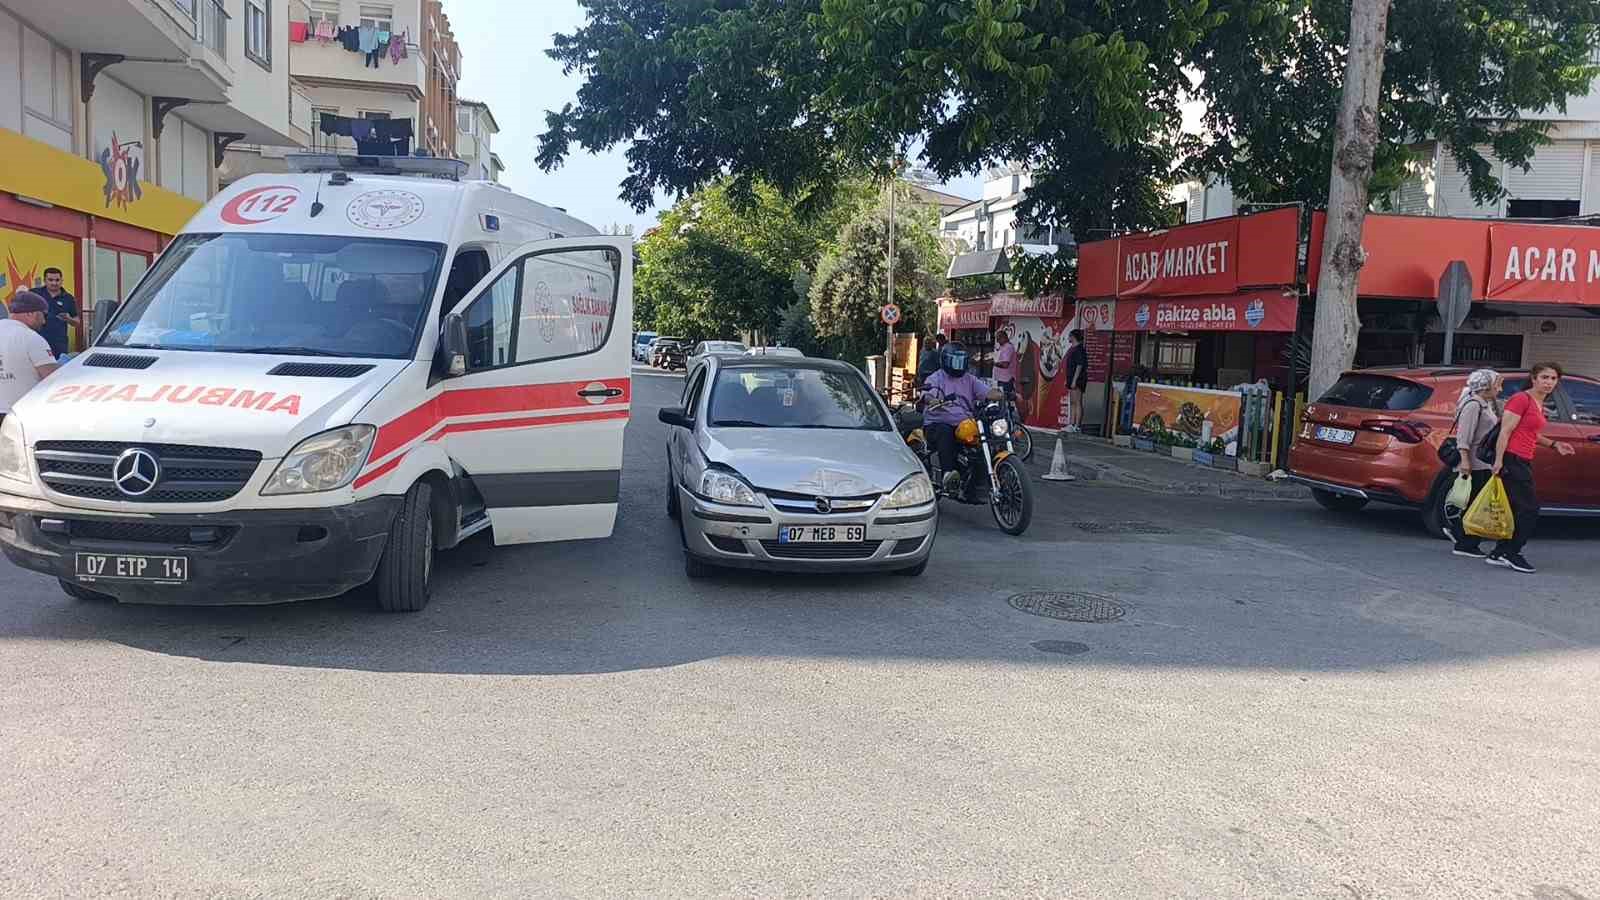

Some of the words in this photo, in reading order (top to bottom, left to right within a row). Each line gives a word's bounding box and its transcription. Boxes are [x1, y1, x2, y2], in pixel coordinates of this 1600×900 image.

[243, 195, 297, 213] 112
[1126, 251, 1158, 281] ACAR
[1162, 240, 1228, 278] MARKET
[1504, 246, 1576, 282] ACAR
[1156, 305, 1200, 326] pakize
[1203, 304, 1236, 321] abla
[789, 527, 804, 541] 07
[812, 527, 835, 541] MEB
[847, 527, 862, 541] 69
[87, 556, 106, 574] 07
[117, 557, 148, 576] ETP
[163, 558, 182, 577] 14
